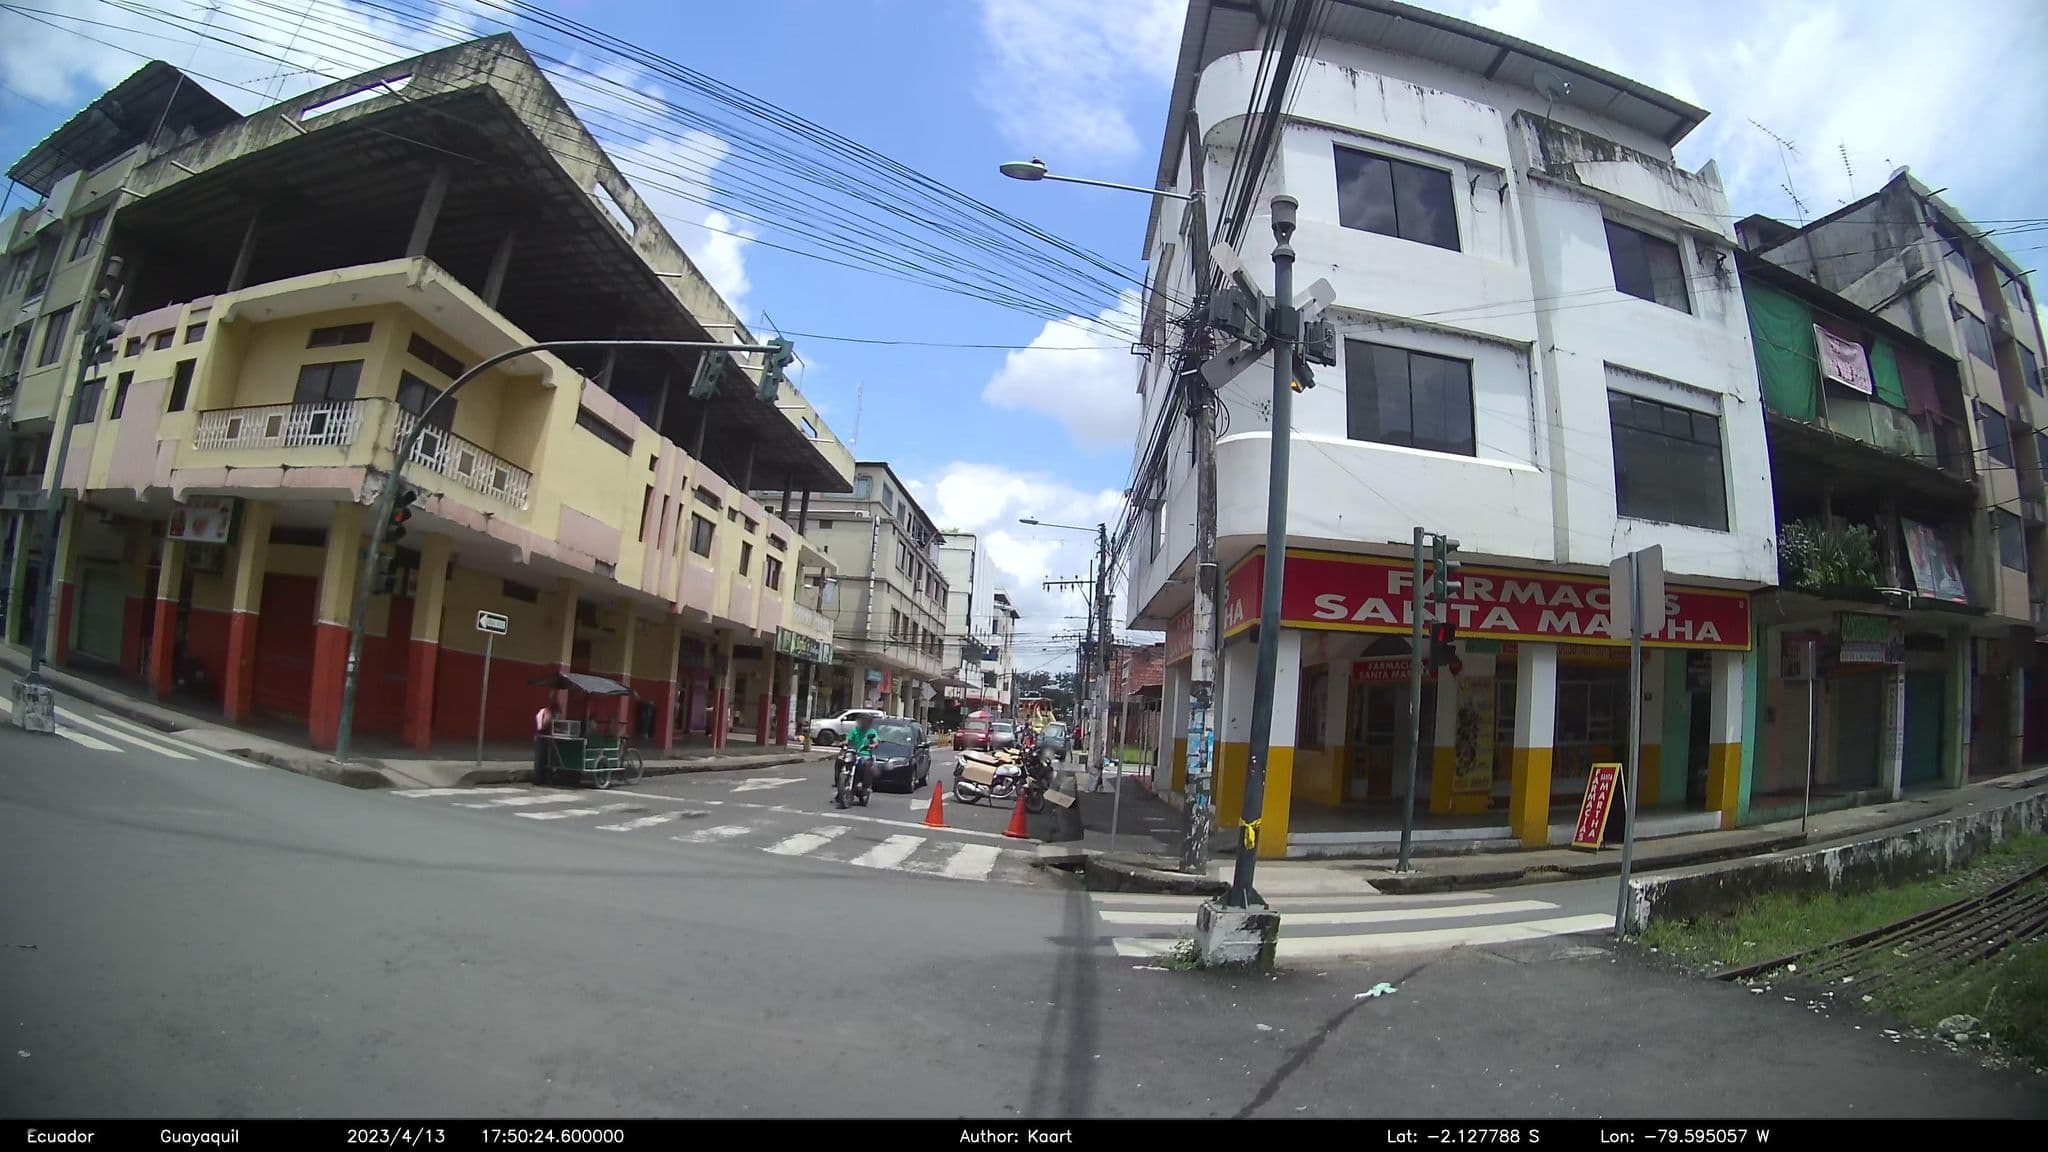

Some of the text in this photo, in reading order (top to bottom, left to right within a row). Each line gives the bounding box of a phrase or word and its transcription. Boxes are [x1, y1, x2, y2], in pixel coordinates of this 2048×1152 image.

[1312, 593, 1723, 642] SANTA MAHA
[1387, 569, 1681, 616] FRMACS
[1578, 769, 1601, 841] FARMACIAS
[1588, 782, 1609, 838] MARTHA
